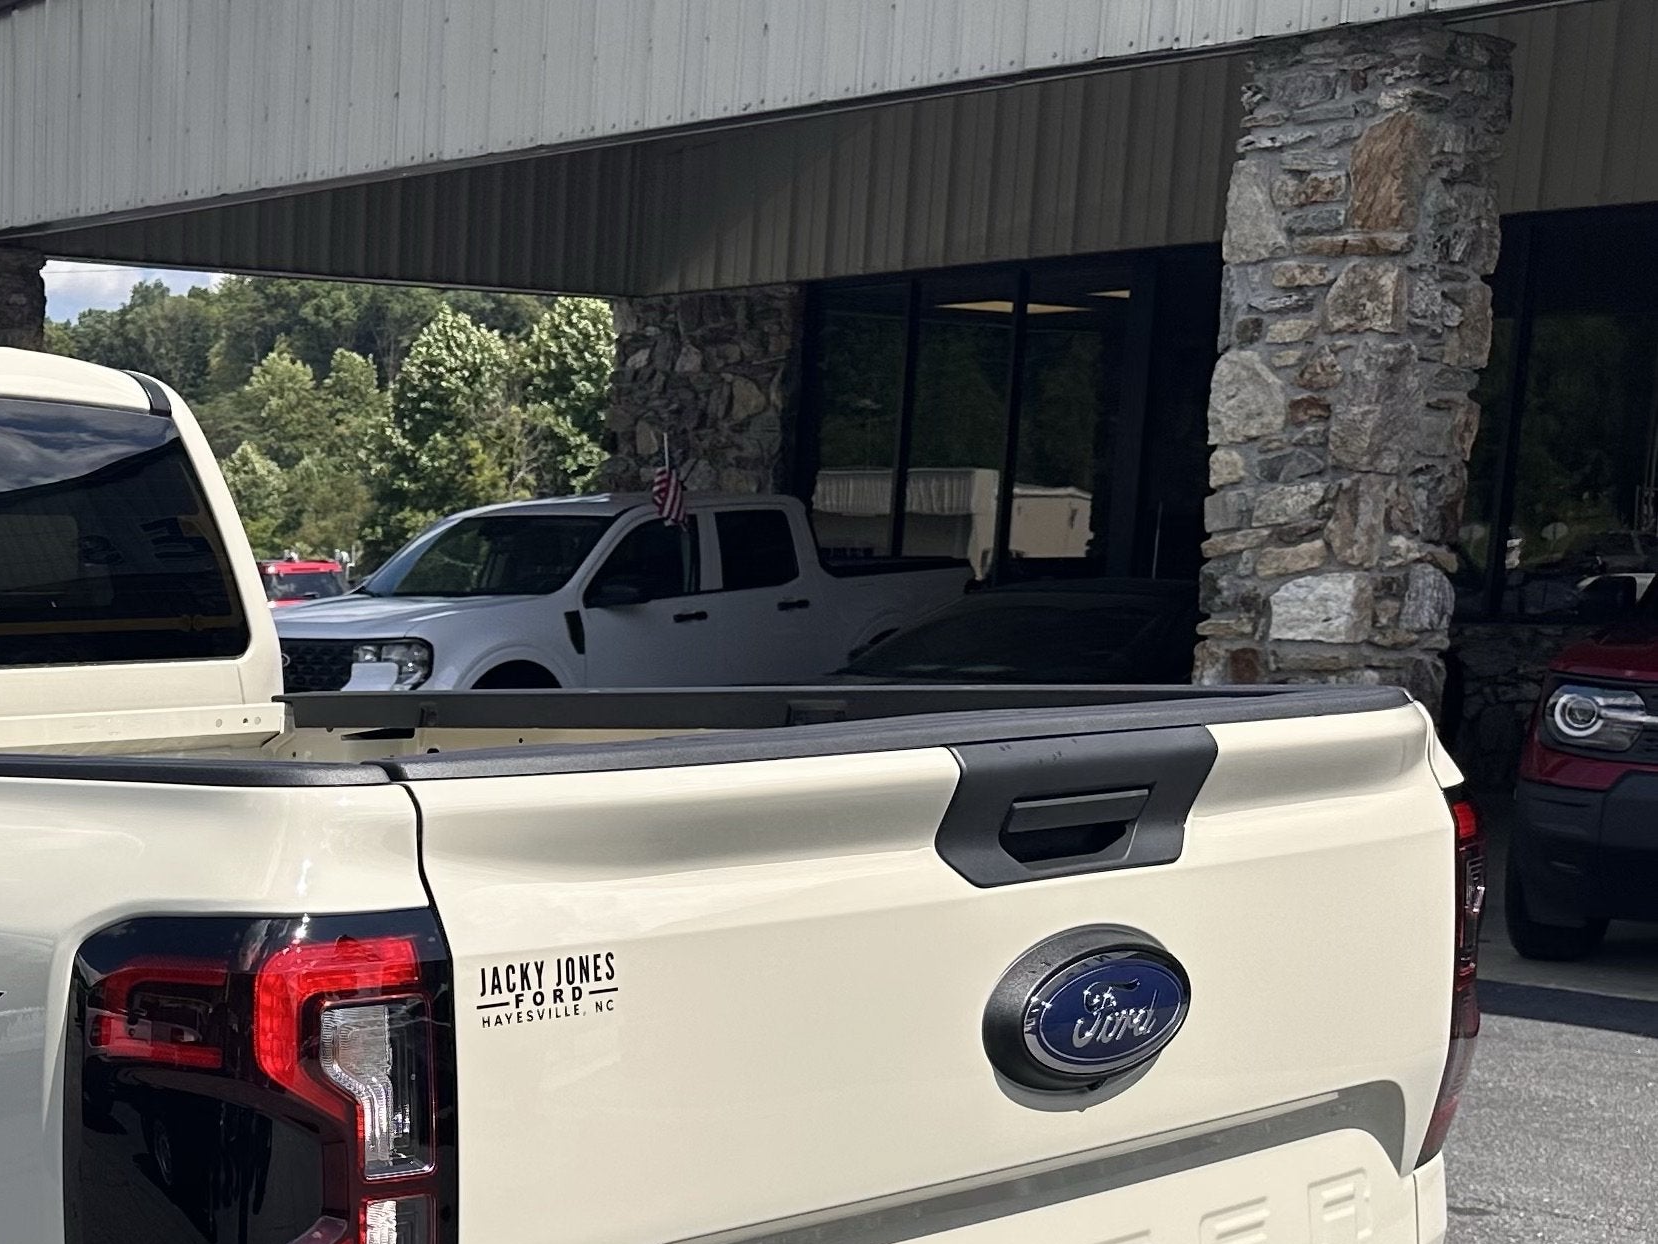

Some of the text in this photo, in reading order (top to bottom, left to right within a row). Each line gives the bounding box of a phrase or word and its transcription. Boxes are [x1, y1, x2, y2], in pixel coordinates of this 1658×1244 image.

[480, 952, 615, 997] JACKY JONES
[482, 999, 615, 1028] HAYESVILLE, NC
[514, 986, 583, 1009] FORD
[1072, 977, 1159, 1048] Ford
